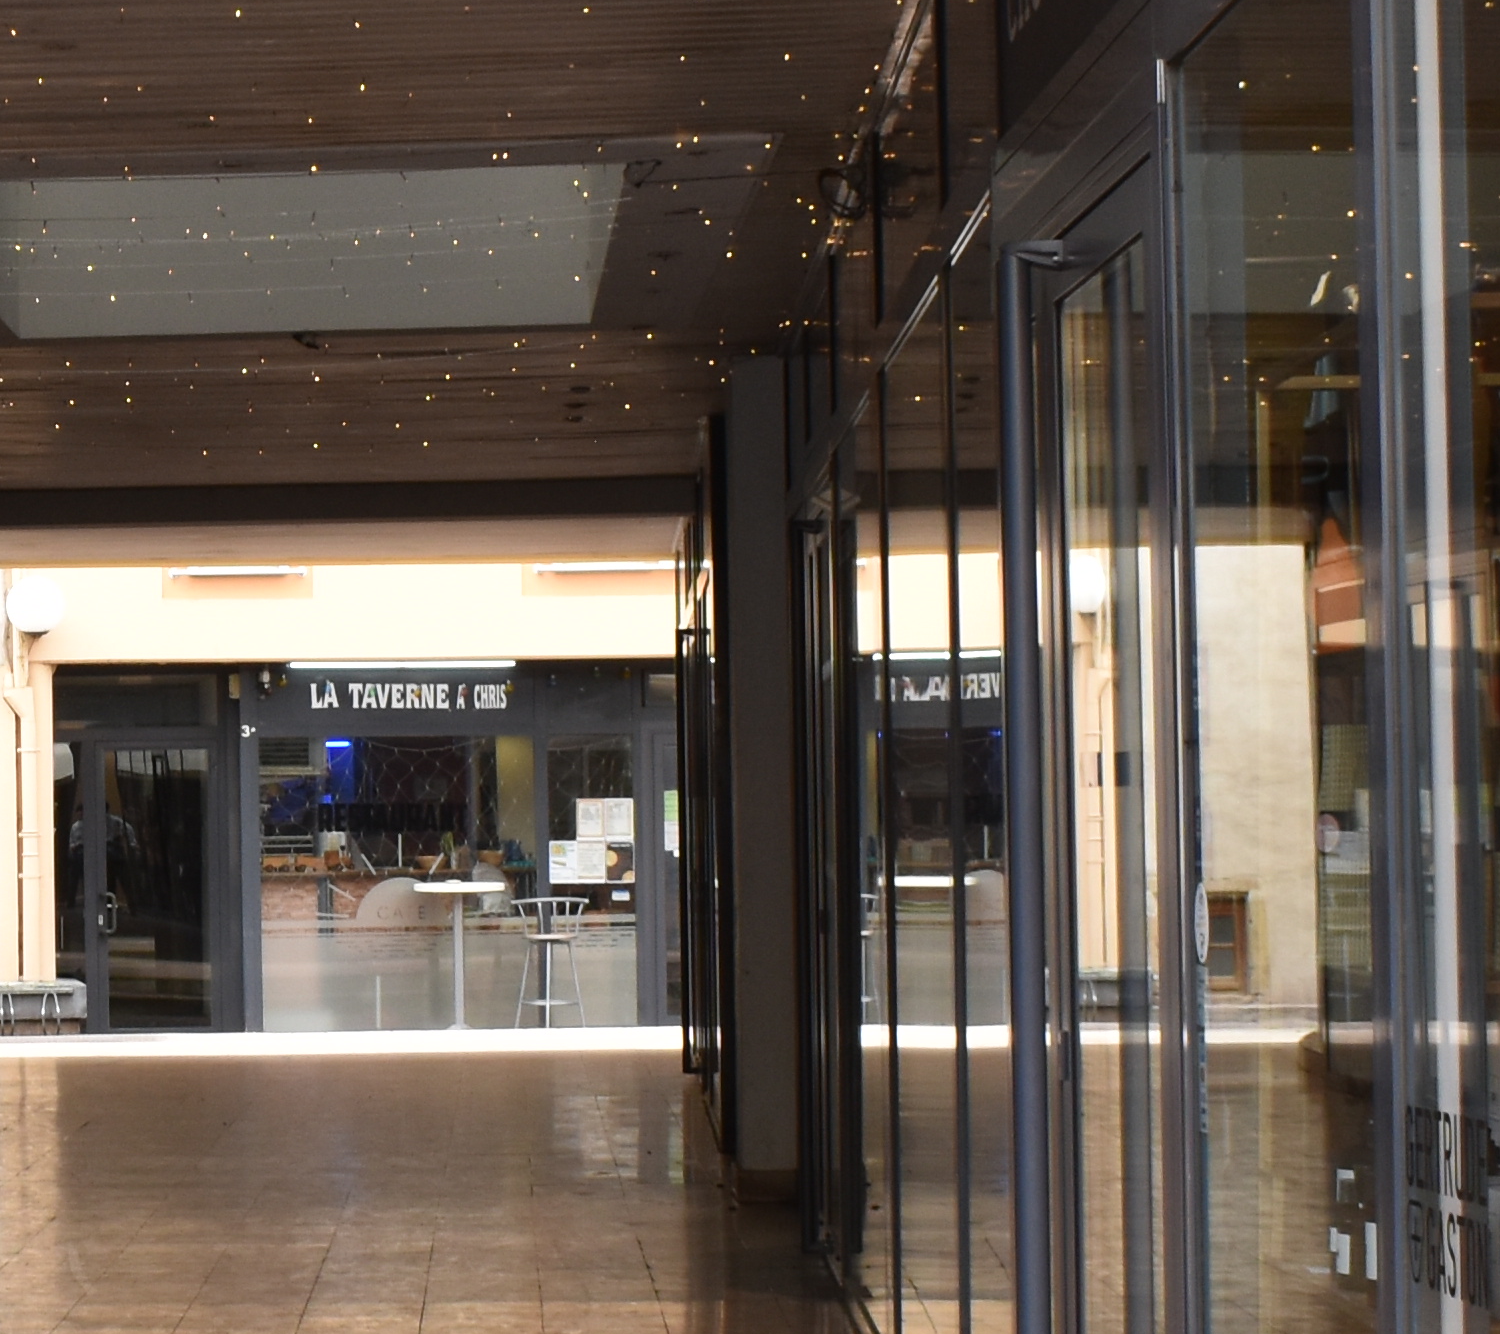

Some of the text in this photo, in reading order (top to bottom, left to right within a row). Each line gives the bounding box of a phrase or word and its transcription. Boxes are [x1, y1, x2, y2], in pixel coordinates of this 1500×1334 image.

[310, 682, 339, 709] LA
[348, 682, 450, 709] TAVERNE
[473, 683, 507, 709] CHRIS
